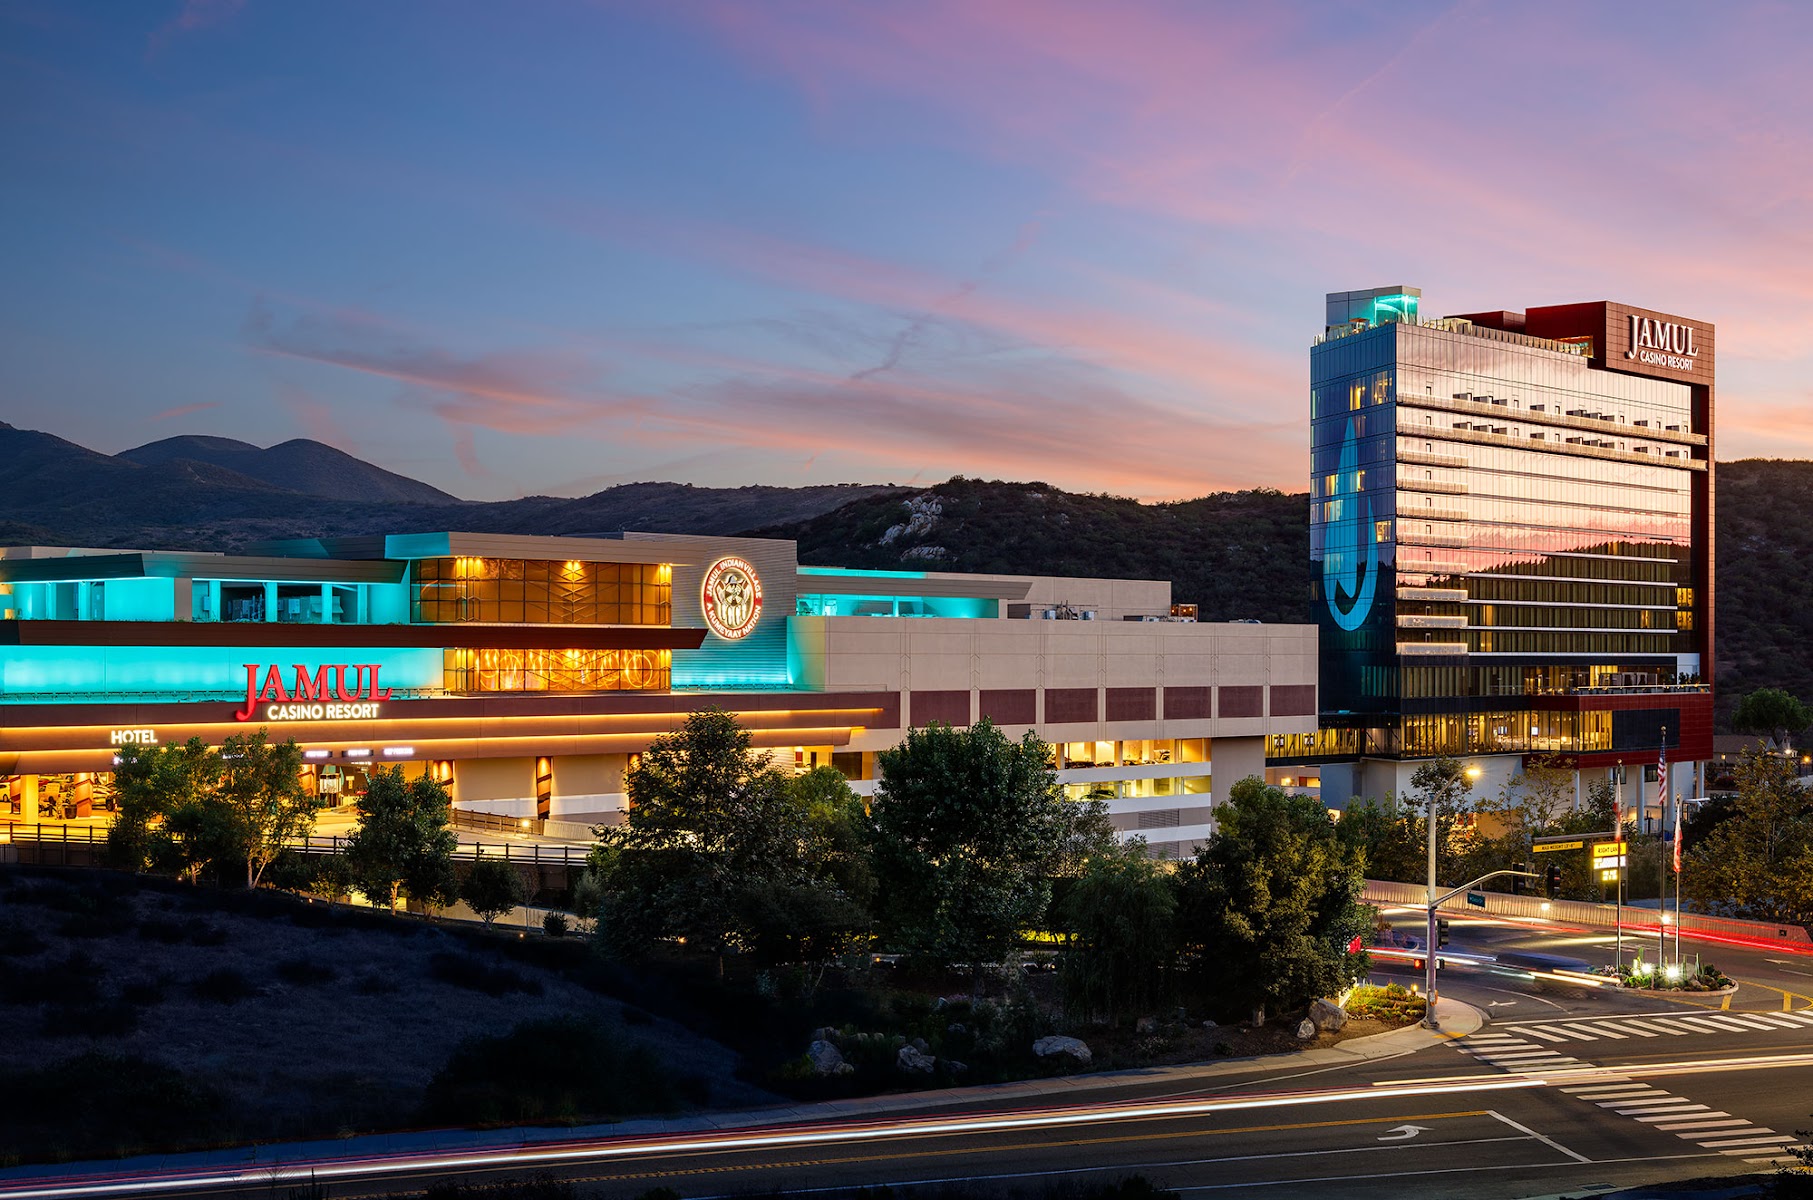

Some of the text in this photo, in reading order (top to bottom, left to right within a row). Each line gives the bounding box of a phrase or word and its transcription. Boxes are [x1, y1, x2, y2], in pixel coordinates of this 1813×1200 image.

[1628, 315, 1699, 360] JAMUL
[1639, 349, 1693, 371] CASINO RESORT
[706, 559, 762, 599] JAMUL INDIAN VILLAGE
[706, 602, 762, 638] A KUMEYAAY NATION
[235, 663, 394, 722] JAMUL
[267, 703, 380, 720] CASINO RESORT
[110, 729, 158, 745] HOTEL
